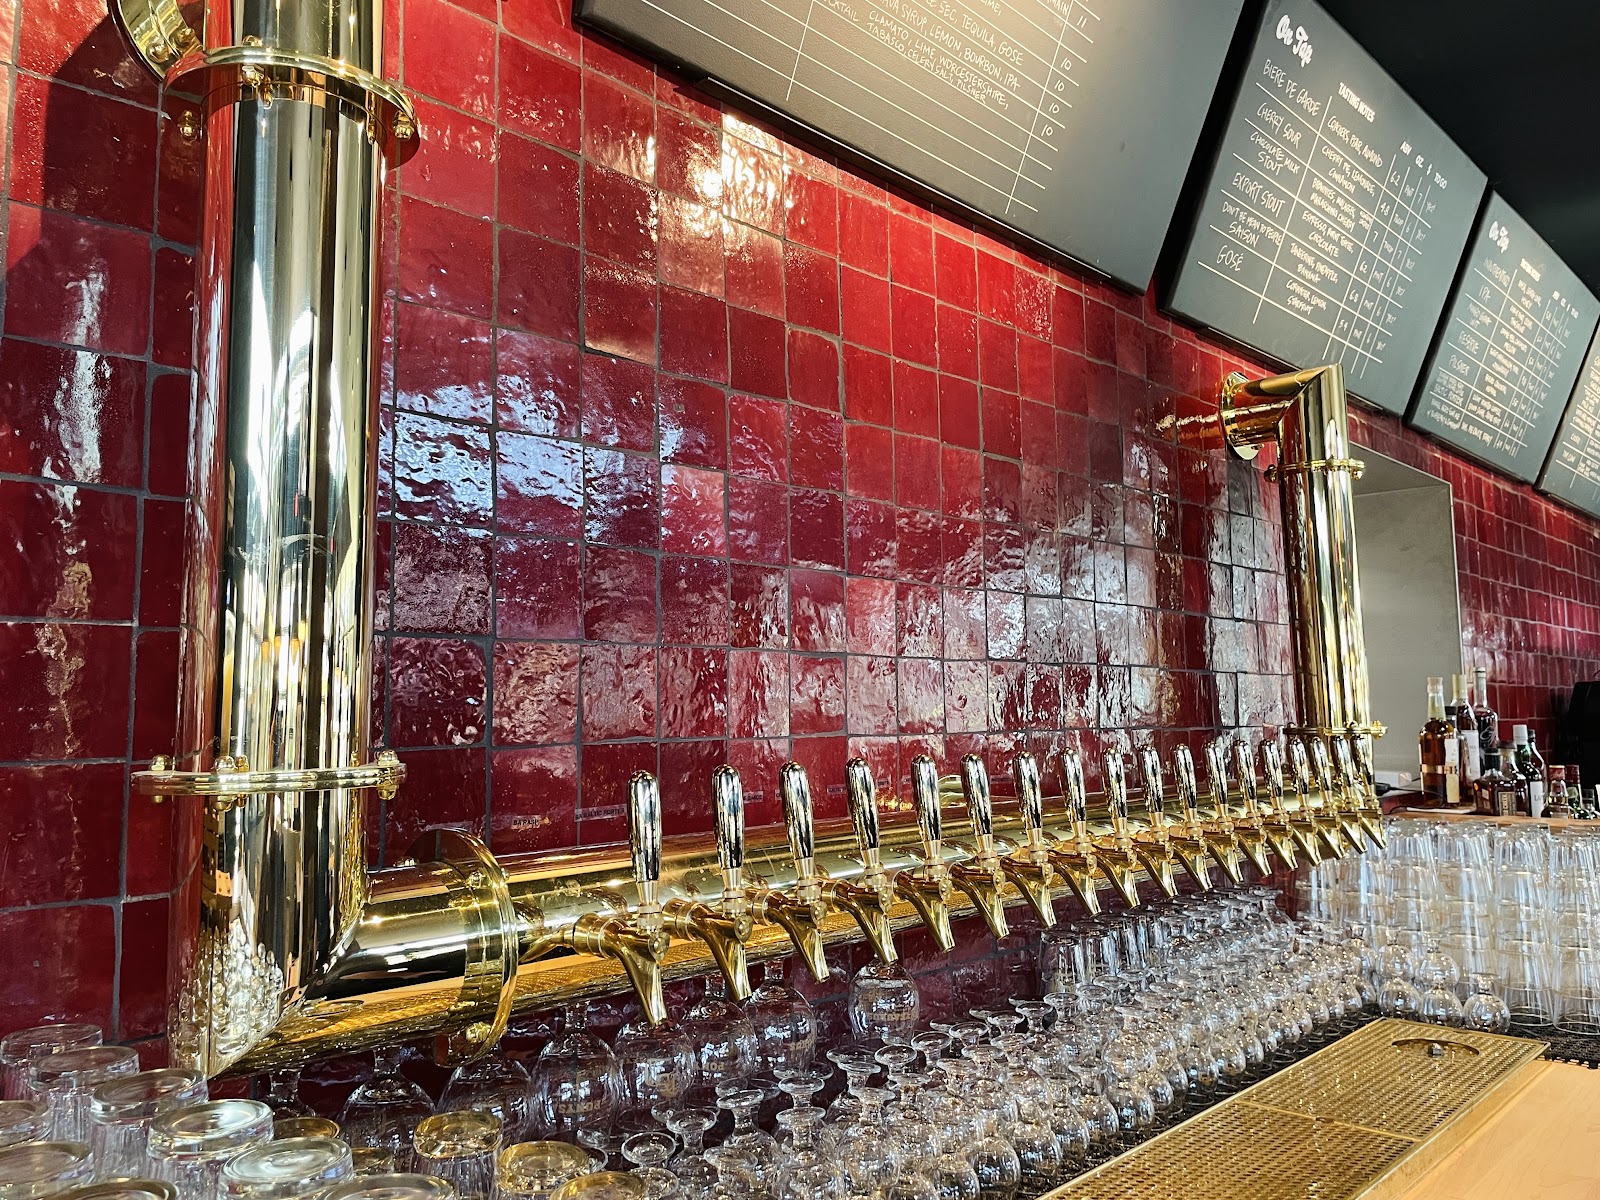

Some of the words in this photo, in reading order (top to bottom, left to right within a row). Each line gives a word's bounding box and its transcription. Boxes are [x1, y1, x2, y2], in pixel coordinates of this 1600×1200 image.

[938, 0, 957, 24] SEC,
[962, 14, 996, 52] TEQUILA,
[998, 41, 1023, 66] GOSE
[929, 24, 962, 58] LEMON,
[964, 48, 1003, 81] BOURBON,
[1003, 73, 1021, 91] IPA
[1292, 26, 1313, 67] Tap
[1060, 57, 1072, 70] 10
[957, 79, 986, 105] PILSNER
[1054, 80, 1065, 91] 10
[1263, 59, 1286, 87] BIERE
[1285, 79, 1298, 98] DE
[1296, 89, 1321, 116] GARDE
[1338, 82, 1360, 109] TASTING
[1049, 102, 1060, 113] 10
[1041, 124, 1053, 136] 10
[1257, 102, 1284, 134] CHERRY
[1283, 123, 1302, 149] SOUR
[1250, 132, 1284, 160] CHOCOLATE
[1284, 157, 1300, 174] MILK
[1258, 151, 1283, 176] STOUT
[1322, 146, 1344, 167] CHERRY
[1232, 172, 1263, 204] EXPORT
[1261, 190, 1286, 218] STOUT
[1417, 193, 1423, 204] 7
[1229, 221, 1260, 248] SAISON
[1239, 211, 1247, 223] BE
[1246, 217, 1260, 230] MEAN
[1259, 224, 1267, 233] TO
[1265, 226, 1282, 246] PEOPLE
[1373, 231, 1378, 242] 7
[1406, 222, 1412, 233] 6
[1308, 231, 1339, 257] CHOCOLATE
[1397, 250, 1402, 259] 7
[1297, 264, 1321, 283] BANANA
[1386, 277, 1392, 288] 6
[1479, 285, 1491, 303] IPA
[1376, 306, 1382, 316] 6
